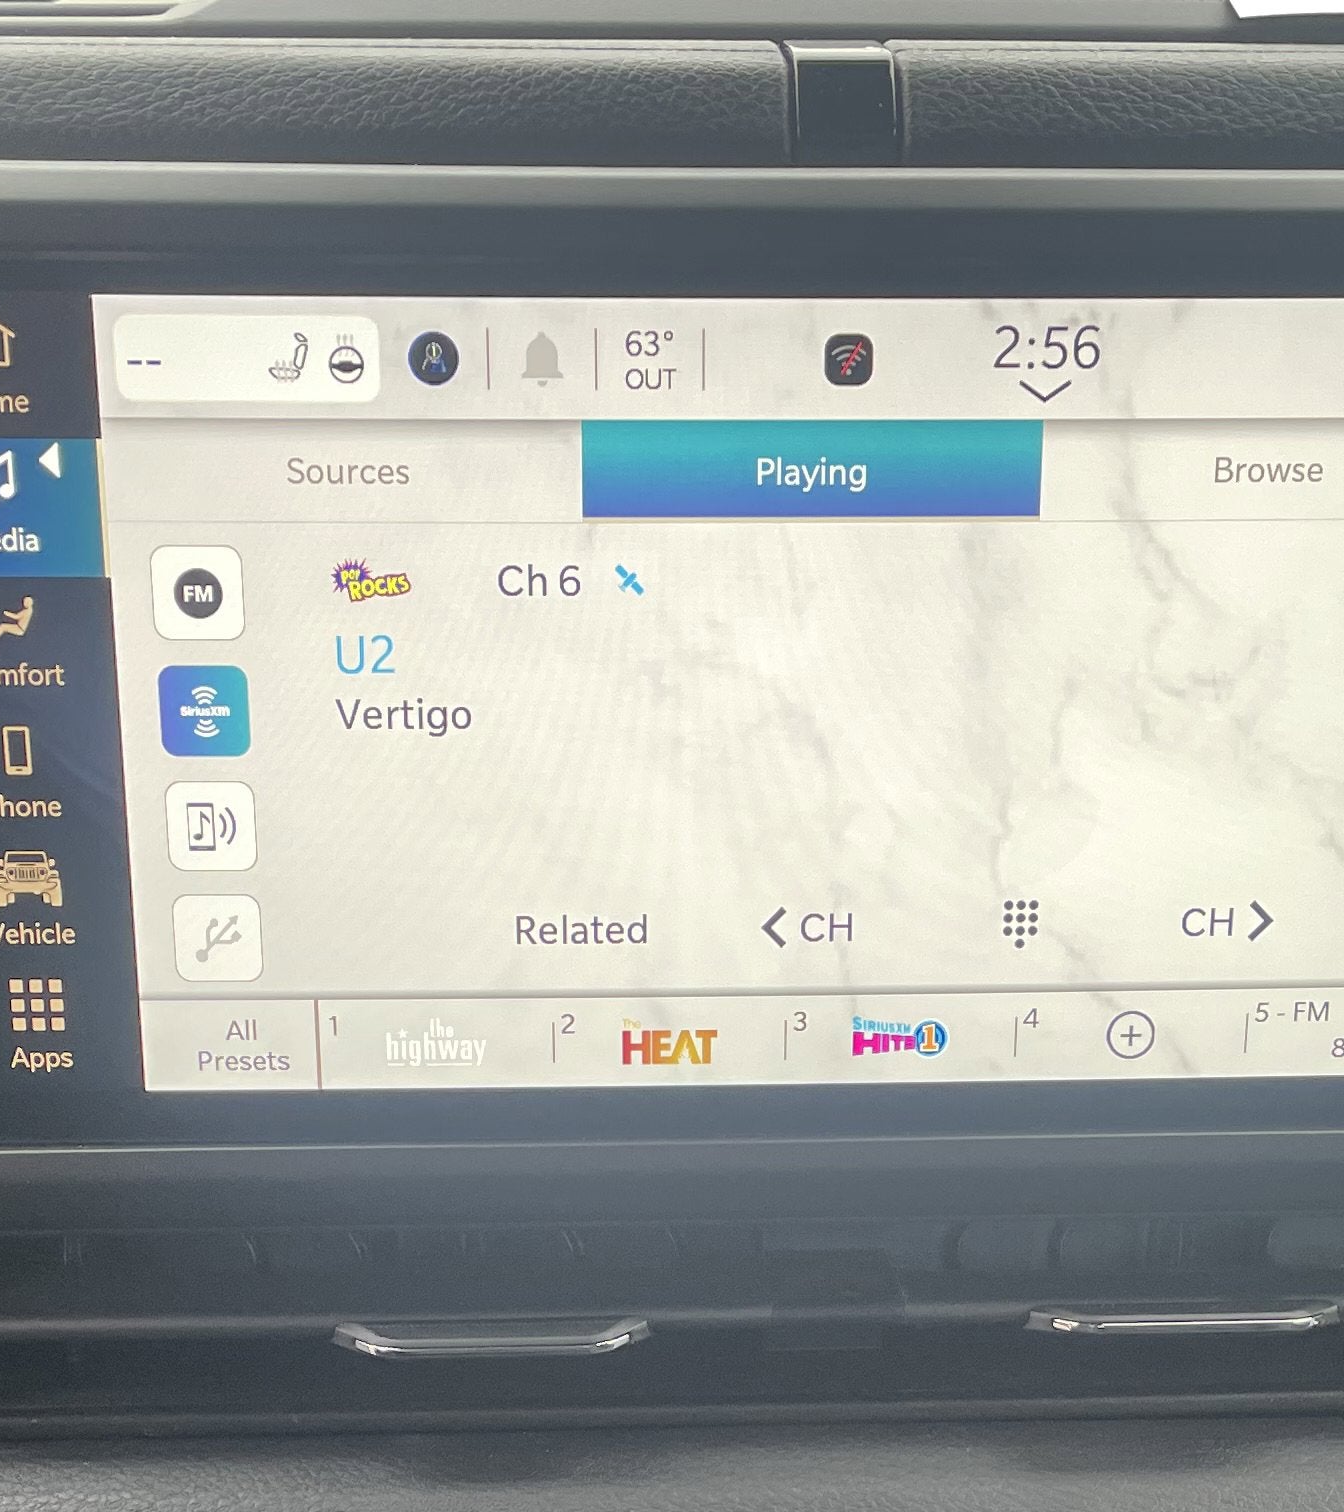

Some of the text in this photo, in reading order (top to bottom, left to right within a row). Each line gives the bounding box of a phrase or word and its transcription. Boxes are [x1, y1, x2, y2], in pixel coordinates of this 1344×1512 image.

[624, 330, 674, 357] 63°
[994, 325, 1101, 370] 2:56
[624, 368, 676, 390] OUT
[286, 458, 410, 485] Sources
[757, 457, 867, 492] Playing
[1213, 456, 1324, 485] Browse
[183, 585, 213, 602] FM
[348, 576, 409, 600] ROCKS
[498, 564, 581, 597] Ch 6
[335, 635, 396, 674] U2
[335, 699, 472, 737] Vertigo
[515, 914, 649, 945] Related
[800, 913, 853, 942] CH
[1181, 907, 1234, 938] CH
[561, 1013, 576, 1034] 2
[793, 1011, 807, 1031] 3
[1023, 1008, 1039, 1028] 4
[1255, 1002, 1269, 1022] 5
[1293, 1001, 1330, 1022] FM
[226, 1019, 256, 1040] All
[328, 1015, 338, 1036] 1
[429, 1018, 454, 1038] the
[11, 1047, 74, 1071] Apps
[386, 1030, 486, 1066] highway
[622, 1029, 718, 1065] HEAT
[198, 1051, 290, 1071] Presets
